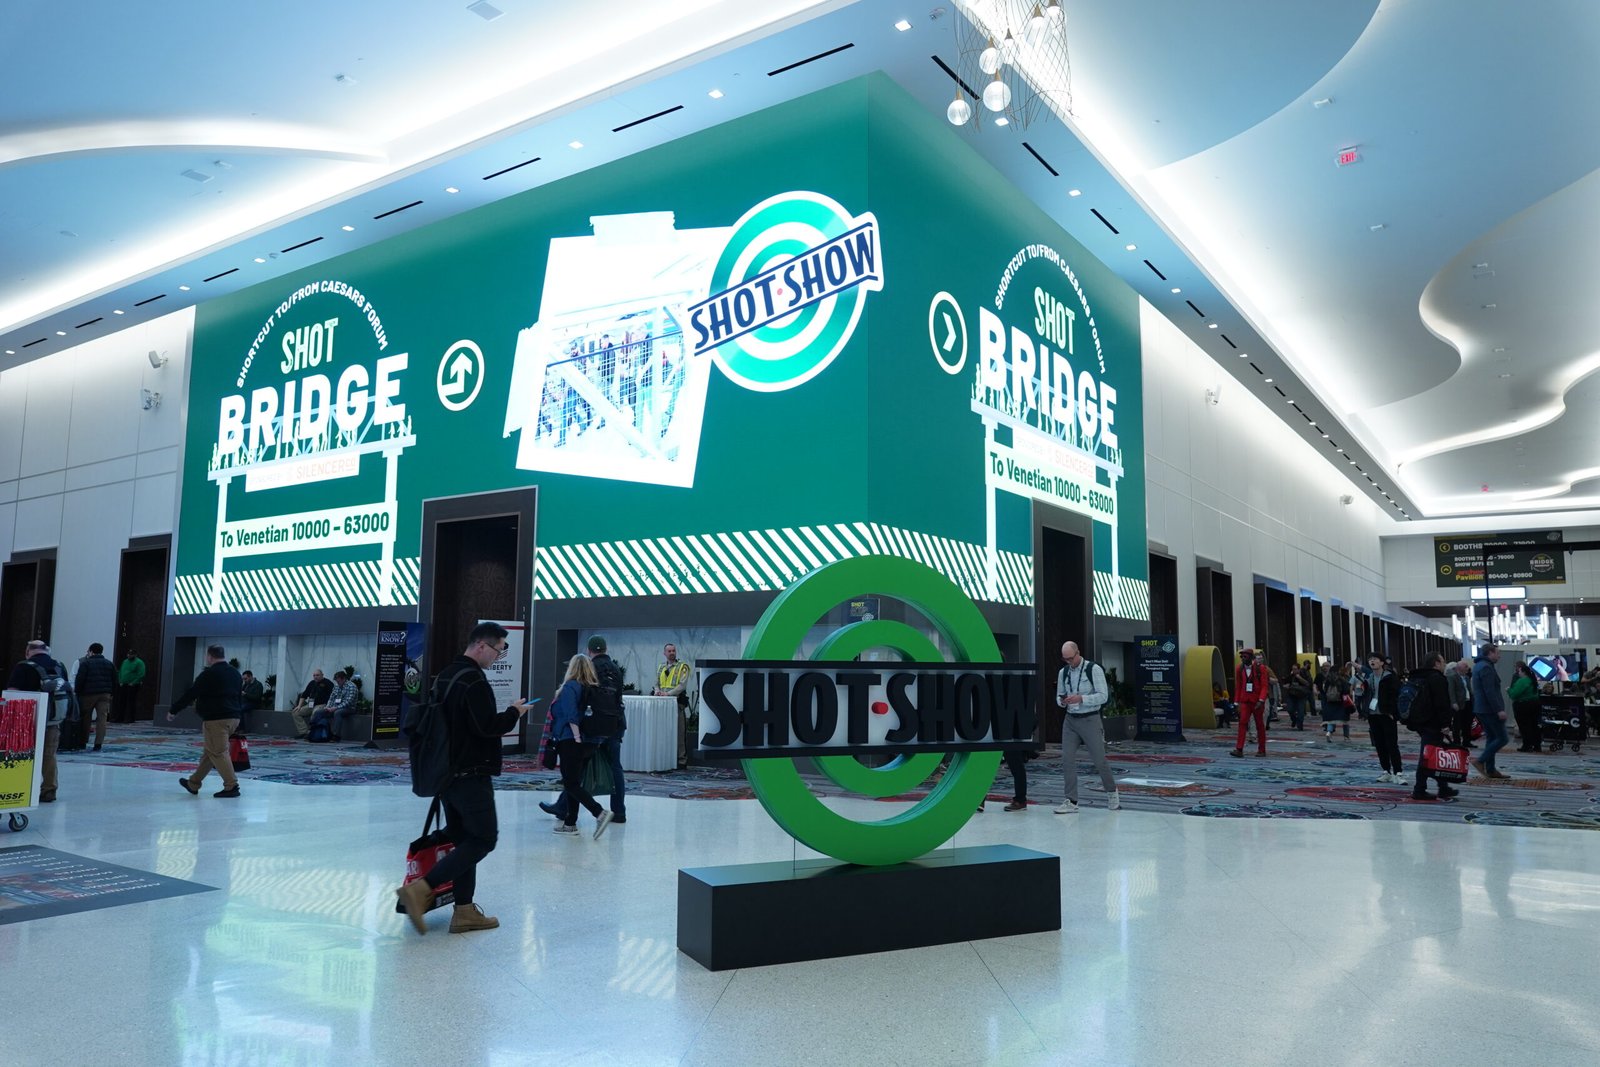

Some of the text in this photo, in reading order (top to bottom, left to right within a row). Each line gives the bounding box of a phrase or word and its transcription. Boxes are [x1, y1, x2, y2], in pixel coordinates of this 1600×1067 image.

[1341, 152, 1354, 164] EXIT
[690, 229, 876, 350] SHOT SHOW
[995, 244, 1106, 374] SHORTCUT TO/FROM CAESARS FORUM
[1034, 286, 1076, 355] SHOT
[236, 280, 388, 388] SHORTCUT TO/FROM CAESARS FORUM
[280, 317, 338, 374] SHOT
[216, 352, 409, 455] BRIDGE
[980, 306, 1119, 450] BRIDGE
[990, 451, 1004, 476] To
[1007, 459, 1053, 495] Venetian
[1054, 476, 1081, 504] 10000
[1089, 488, 1114, 516] 63000
[220, 530, 233, 548] To
[236, 526, 289, 546] Venetian
[292, 519, 330, 541] 10000
[344, 512, 390, 536] 63000
[700, 671, 1038, 746] SHOT SHOW
